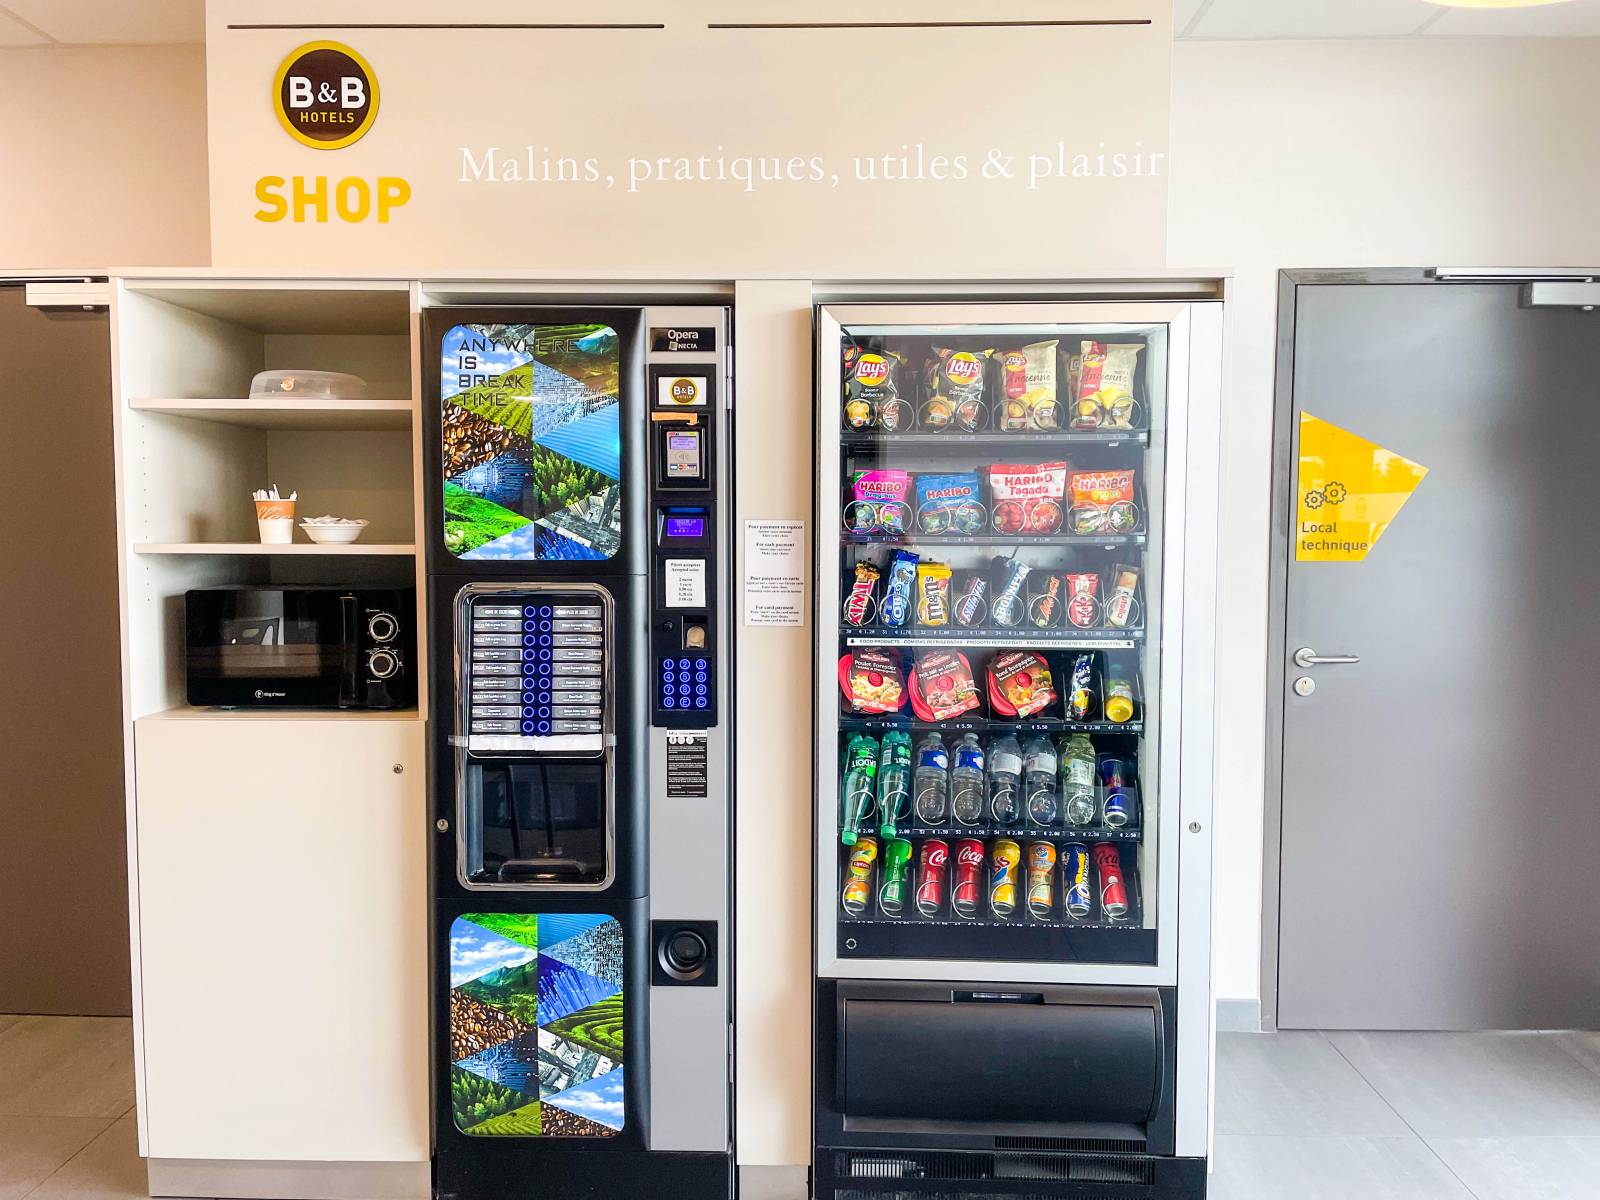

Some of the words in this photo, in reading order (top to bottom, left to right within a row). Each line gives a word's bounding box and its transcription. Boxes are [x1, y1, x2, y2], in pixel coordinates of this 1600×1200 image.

[288, 76, 366, 110] B&B
[300, 111, 355, 124] HOTELS
[458, 146, 615, 188] Malins,
[627, 145, 839, 193] pratiques,
[854, 143, 969, 182] utiles
[981, 147, 1015, 181] &
[1027, 141, 1166, 191] plaisir
[254, 175, 412, 224] SHOP
[667, 329, 699, 341] Opera
[459, 338, 582, 353] ANYWHERE
[458, 356, 477, 370] IS
[458, 374, 525, 389] BREAK
[673, 385, 695, 396] B&B
[459, 392, 508, 407] TIME
[860, 481, 903, 493] HARIBO
[1003, 473, 1053, 487] HARIBO
[1080, 477, 1129, 491] HARIBO
[926, 487, 972, 500] HARIBO
[1010, 486, 1049, 496] Tagada
[1301, 521, 1337, 534] Local
[1301, 539, 1368, 552] technique
[848, 579, 876, 625] TWIX
[892, 583, 903, 620] OREO
[855, 659, 872, 667] Poulet
